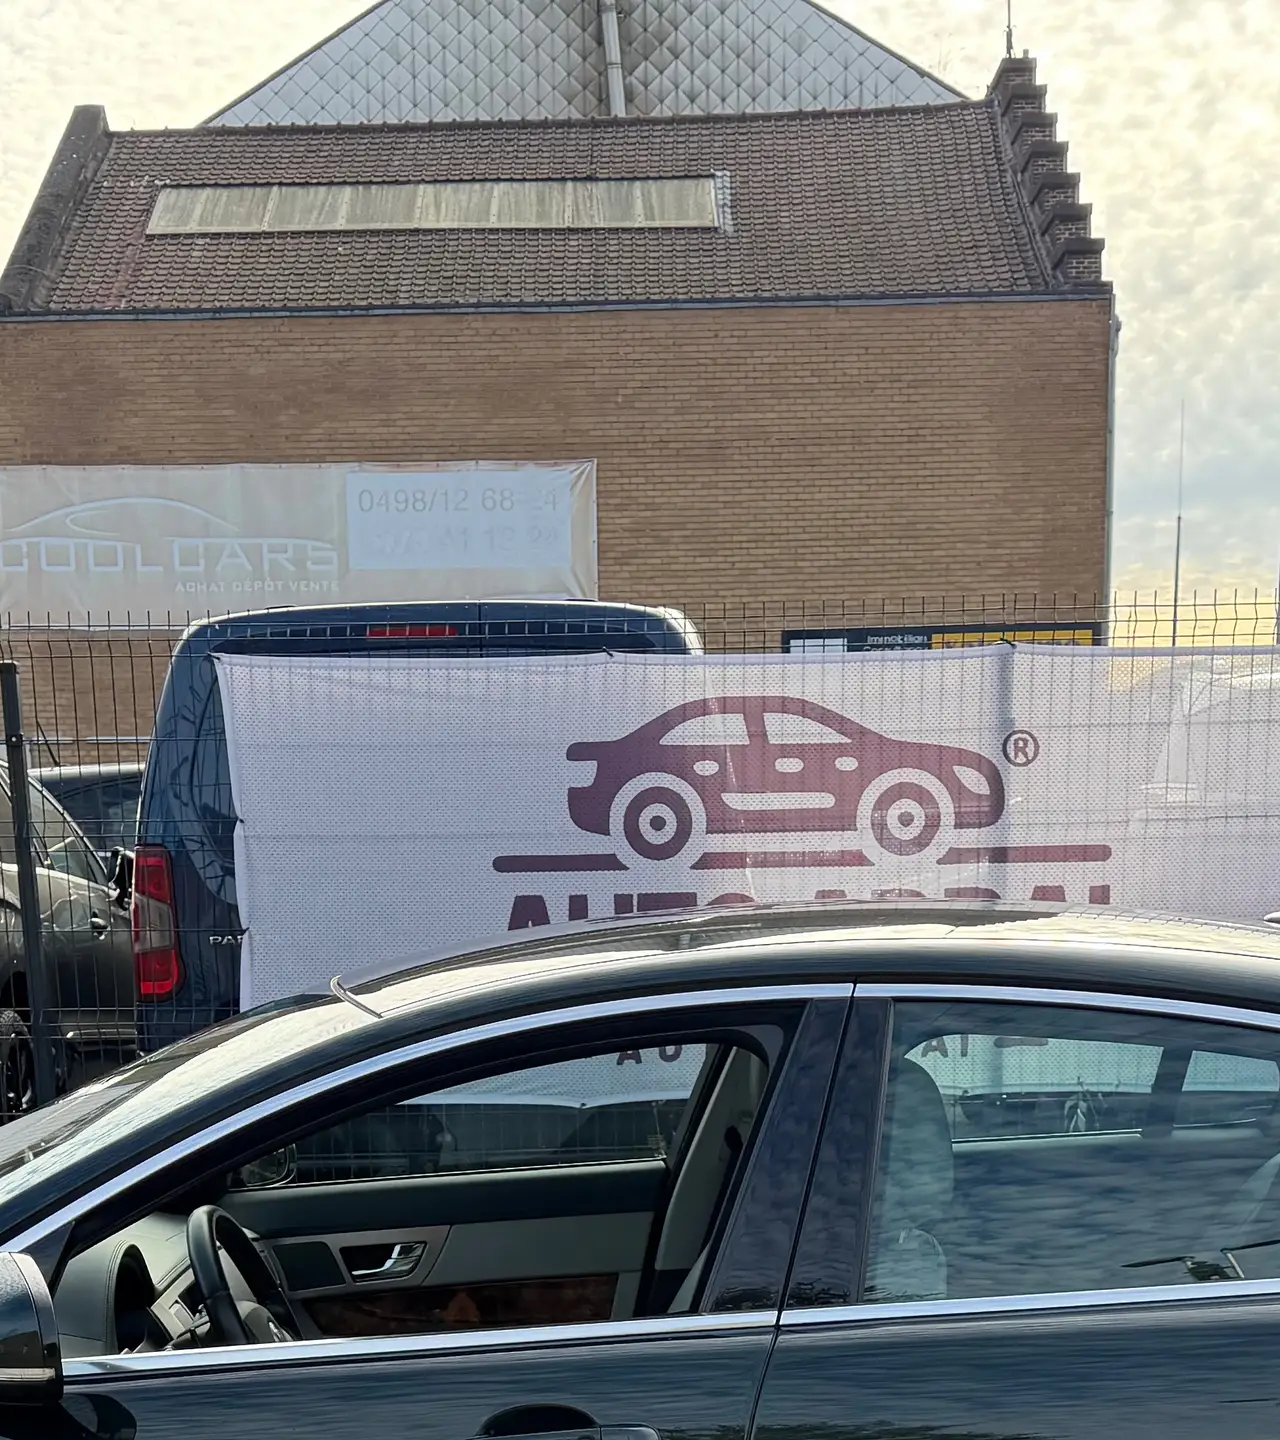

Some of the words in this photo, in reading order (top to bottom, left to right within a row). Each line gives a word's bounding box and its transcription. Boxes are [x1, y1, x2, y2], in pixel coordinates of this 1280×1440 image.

[358, 487, 471, 513] 0498/12
[481, 487, 515, 512] 68
[174, 580, 226, 592] ACHAT
[288, 579, 341, 592] VENTE
